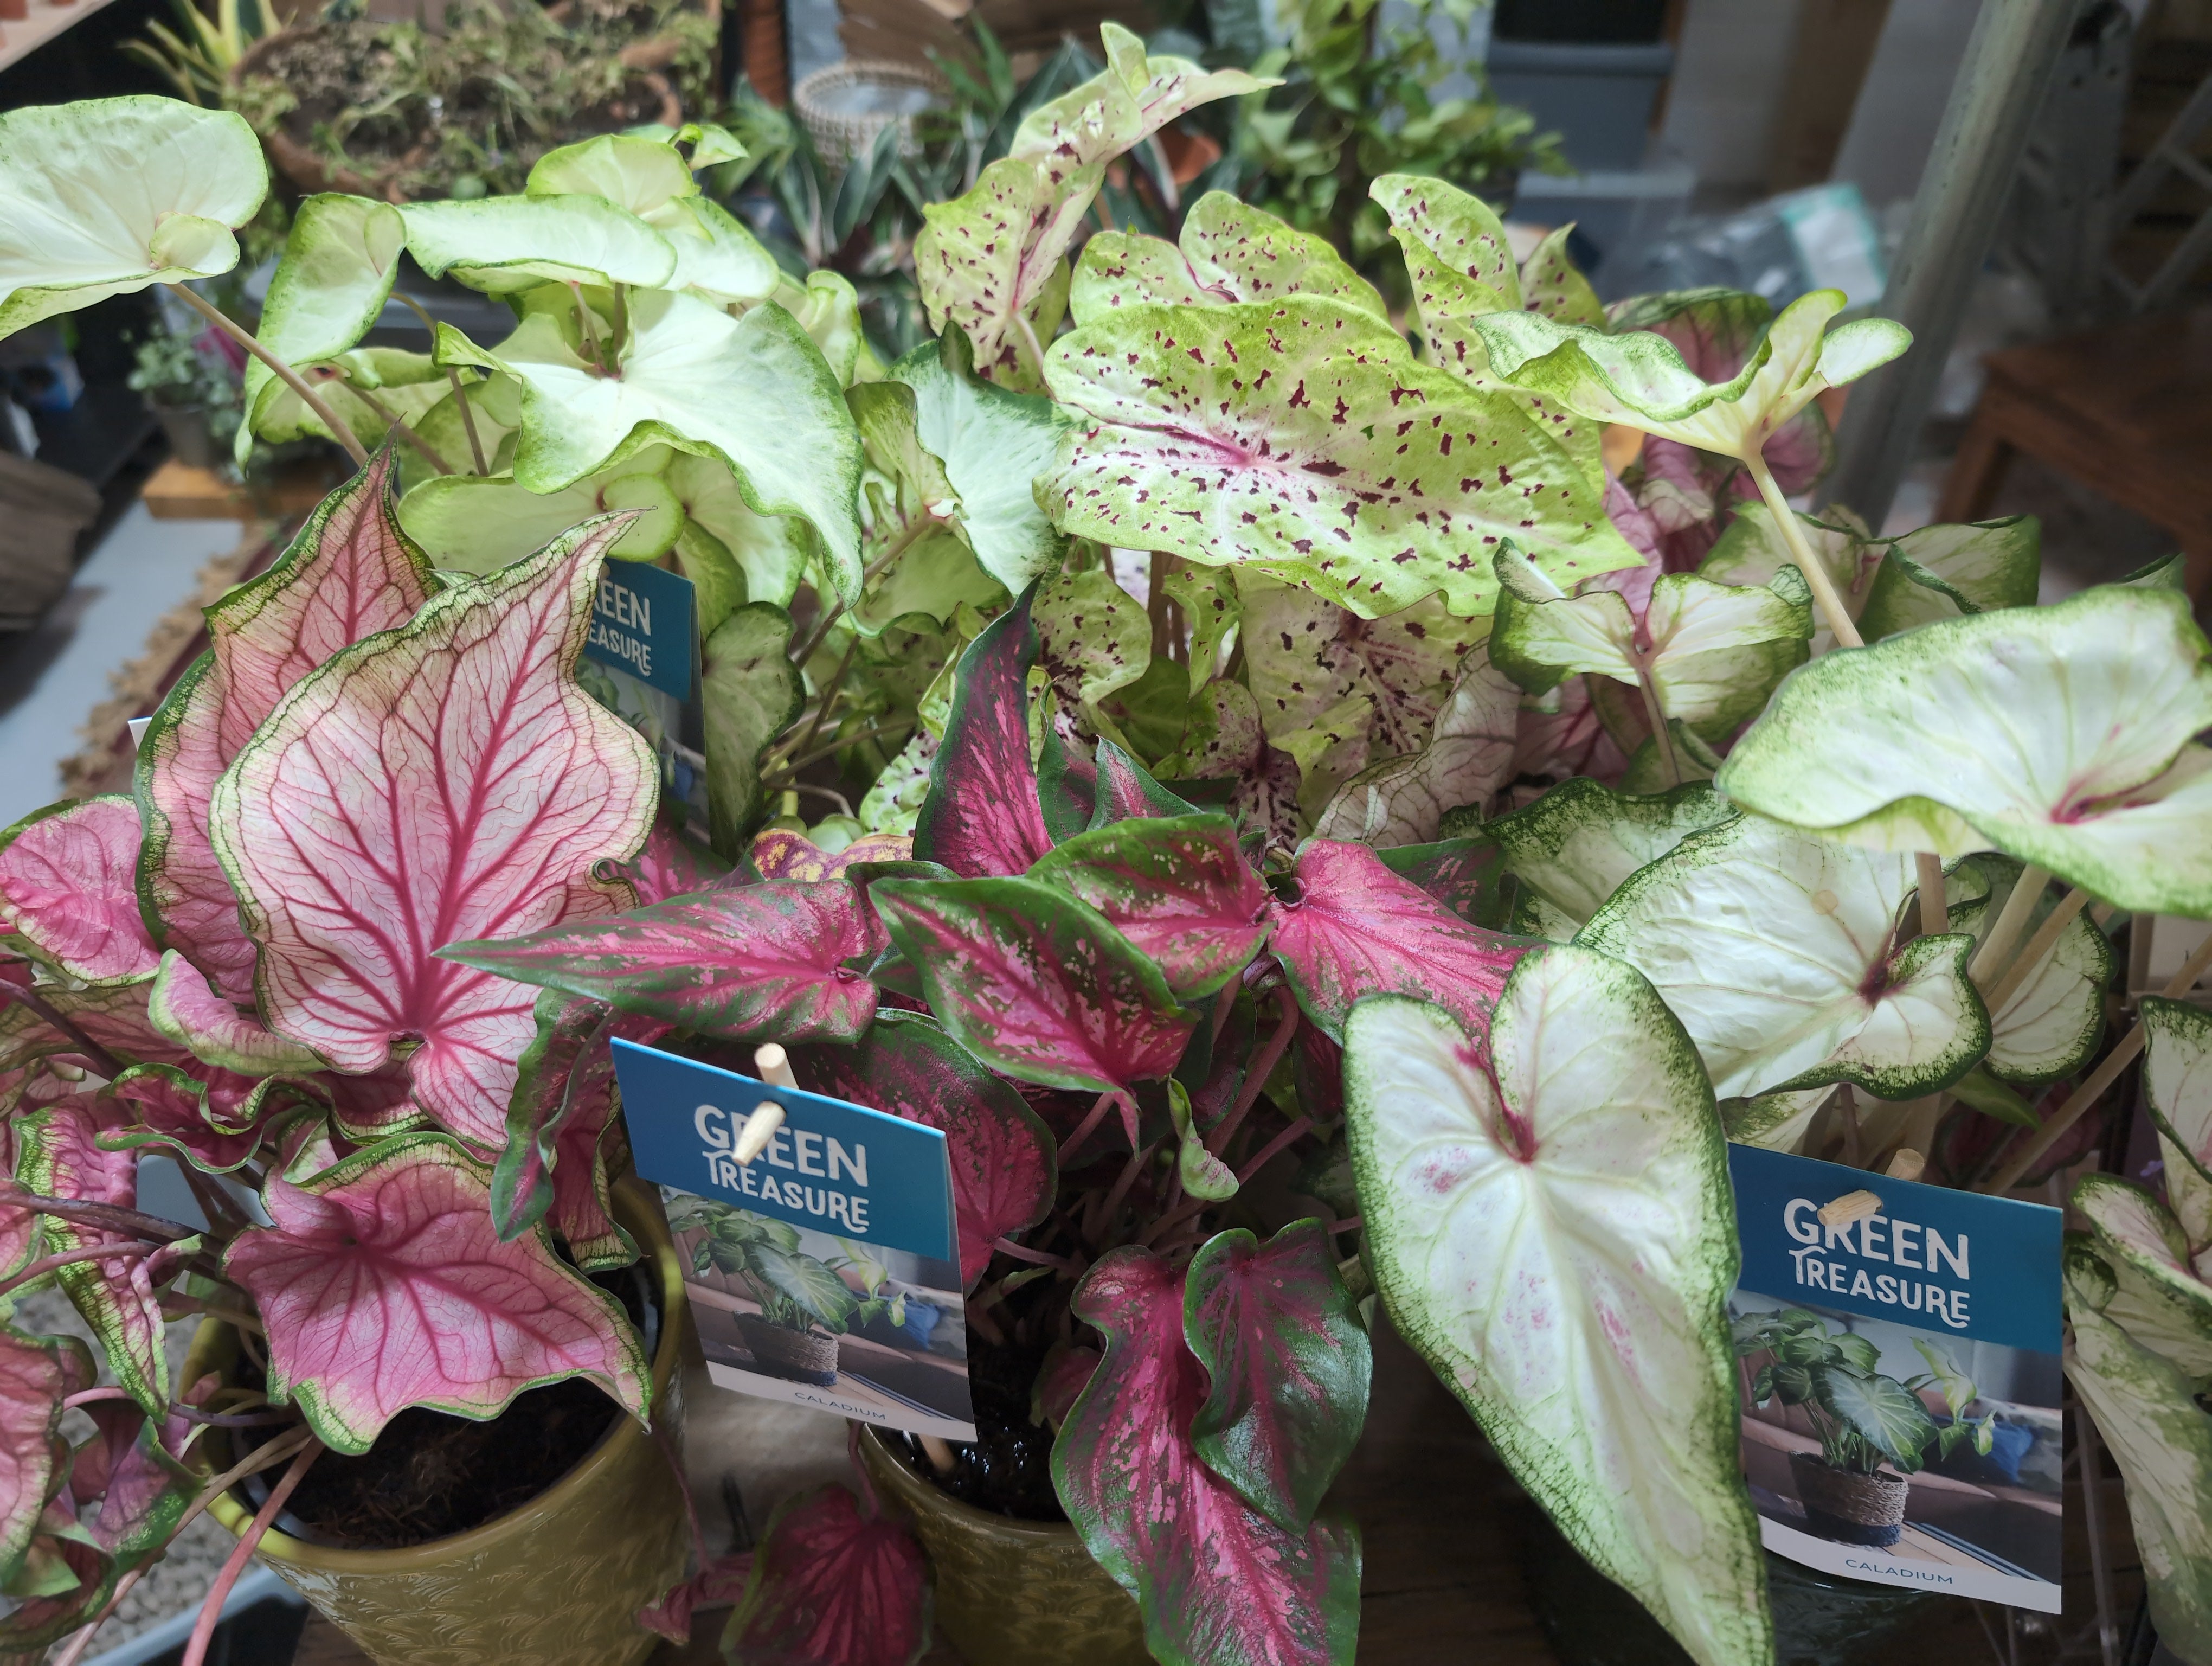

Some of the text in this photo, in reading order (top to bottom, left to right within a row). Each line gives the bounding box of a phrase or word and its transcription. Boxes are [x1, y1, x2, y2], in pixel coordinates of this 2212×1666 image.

[594, 580, 651, 636] EEN
[589, 619, 652, 677] EASURE
[702, 1149, 870, 1234] TREASURE
[1788, 1245, 1971, 1329] TREASURE
[795, 1392, 886, 1420] CALADIUM
[1845, 1559, 1953, 1584] CALADIUM
